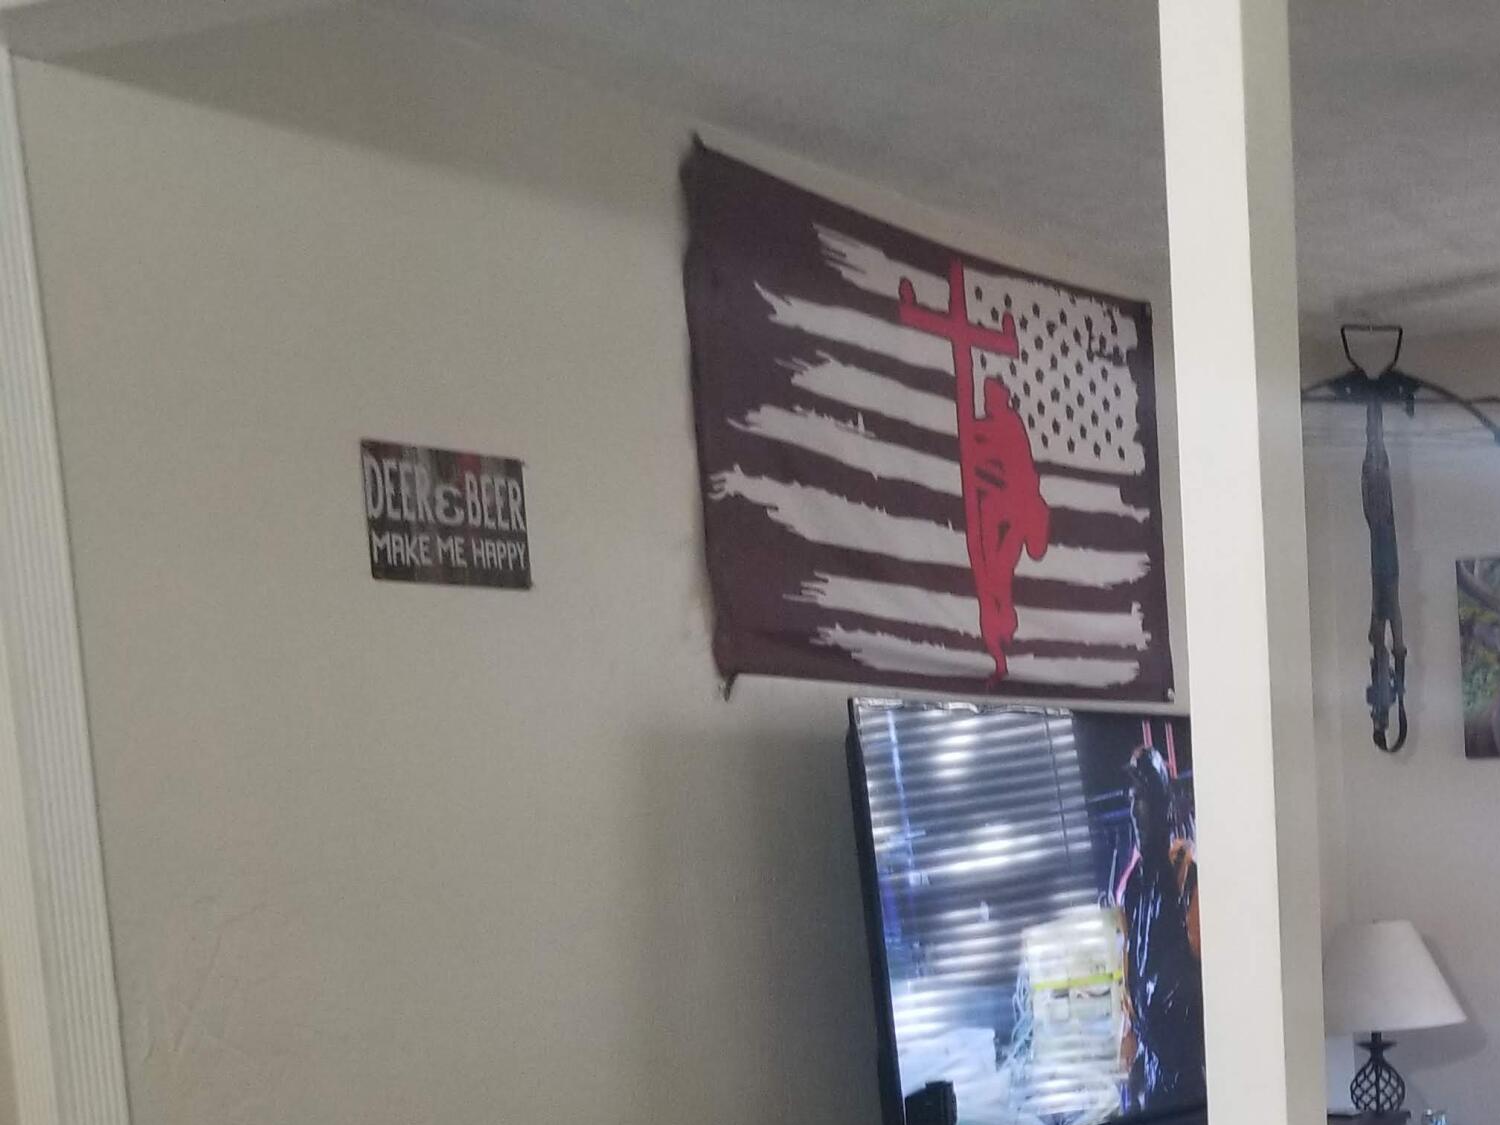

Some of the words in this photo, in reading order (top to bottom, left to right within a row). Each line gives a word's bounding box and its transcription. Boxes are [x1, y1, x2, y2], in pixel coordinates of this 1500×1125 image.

[363, 452, 435, 524] DEER
[435, 484, 464, 526] &
[464, 471, 526, 531] BEER
[371, 530, 432, 567] MAKE
[436, 534, 468, 568] ME
[472, 537, 526, 571] HAPPY
